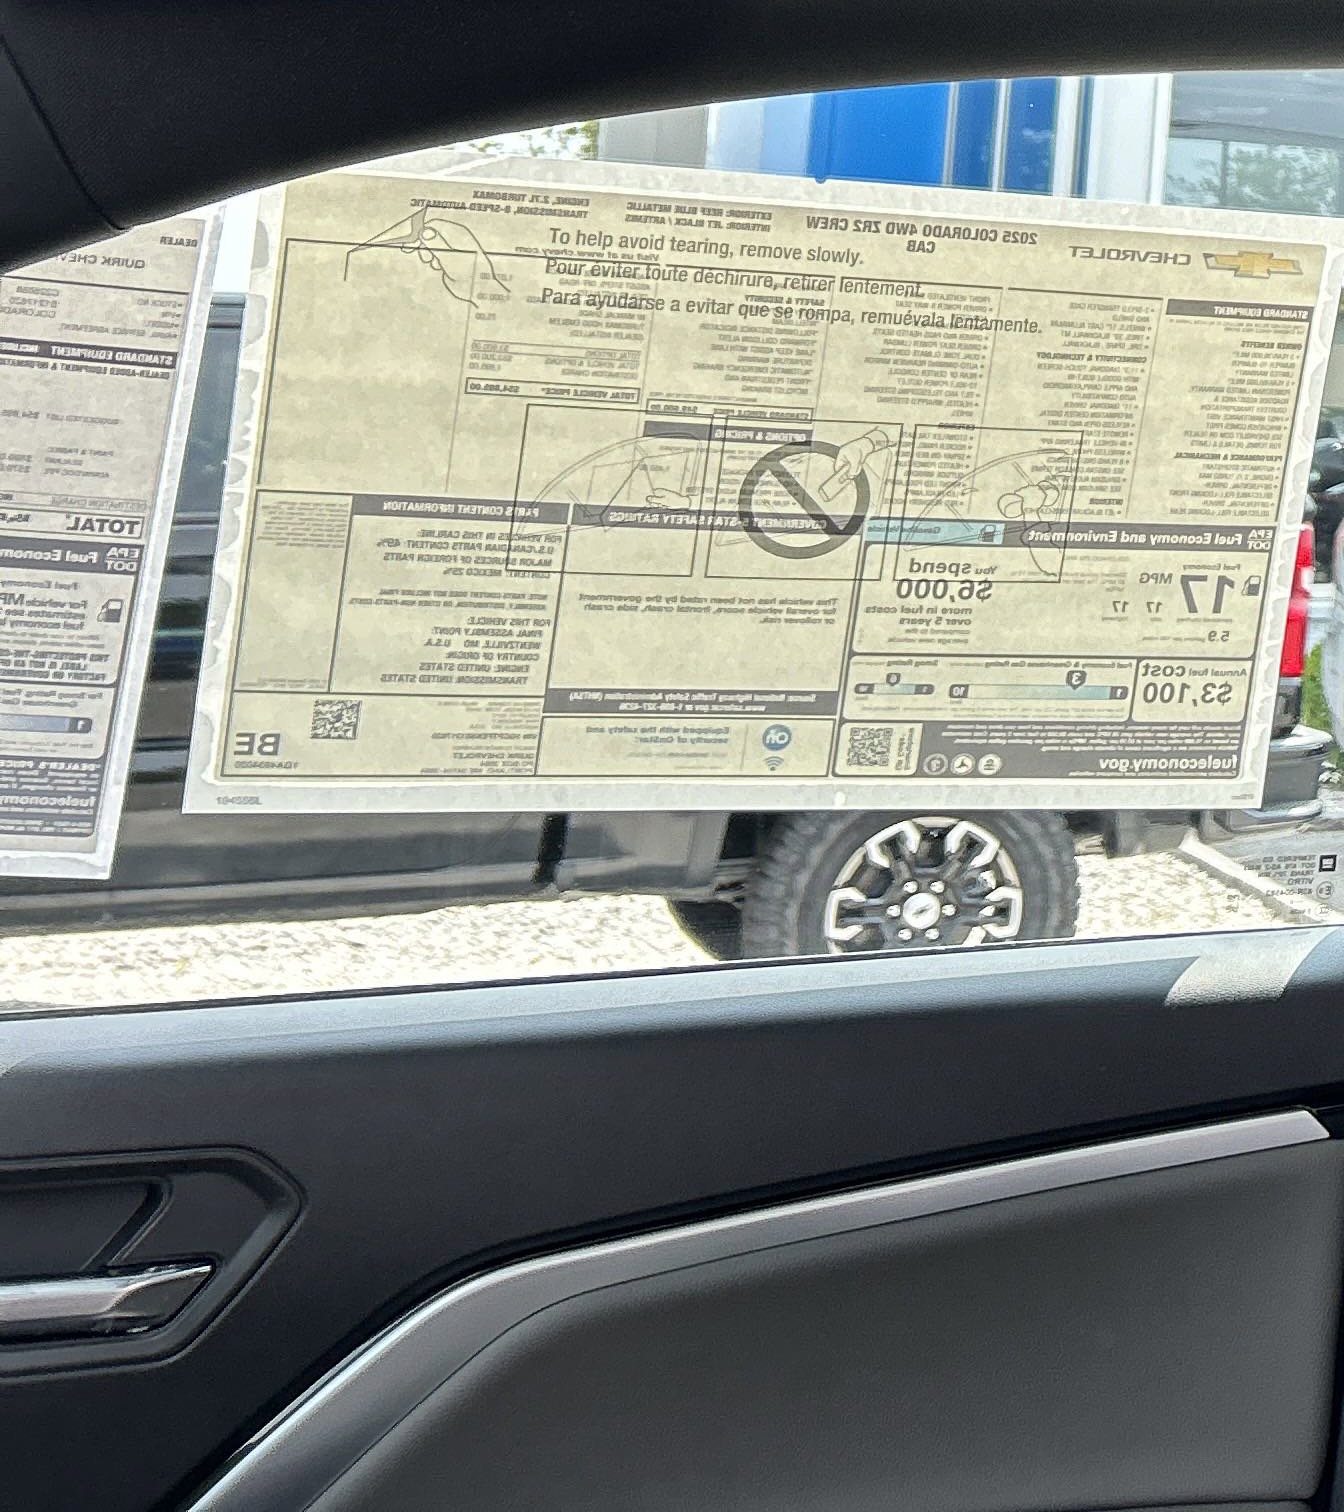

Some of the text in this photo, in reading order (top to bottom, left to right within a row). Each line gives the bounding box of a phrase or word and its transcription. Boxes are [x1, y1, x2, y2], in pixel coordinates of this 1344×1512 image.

[550, 228, 864, 267] To help avoid tearing, remove slowly.
[545, 259, 582, 275] Pour
[644, 265, 687, 282] toute
[541, 288, 580, 305] Para
[586, 292, 664, 311] ayudarse
[670, 299, 680, 311] a
[685, 300, 733, 314] evitar
[739, 304, 769, 319] que
[774, 306, 793, 319] se
[861, 310, 944, 328] remuévala
